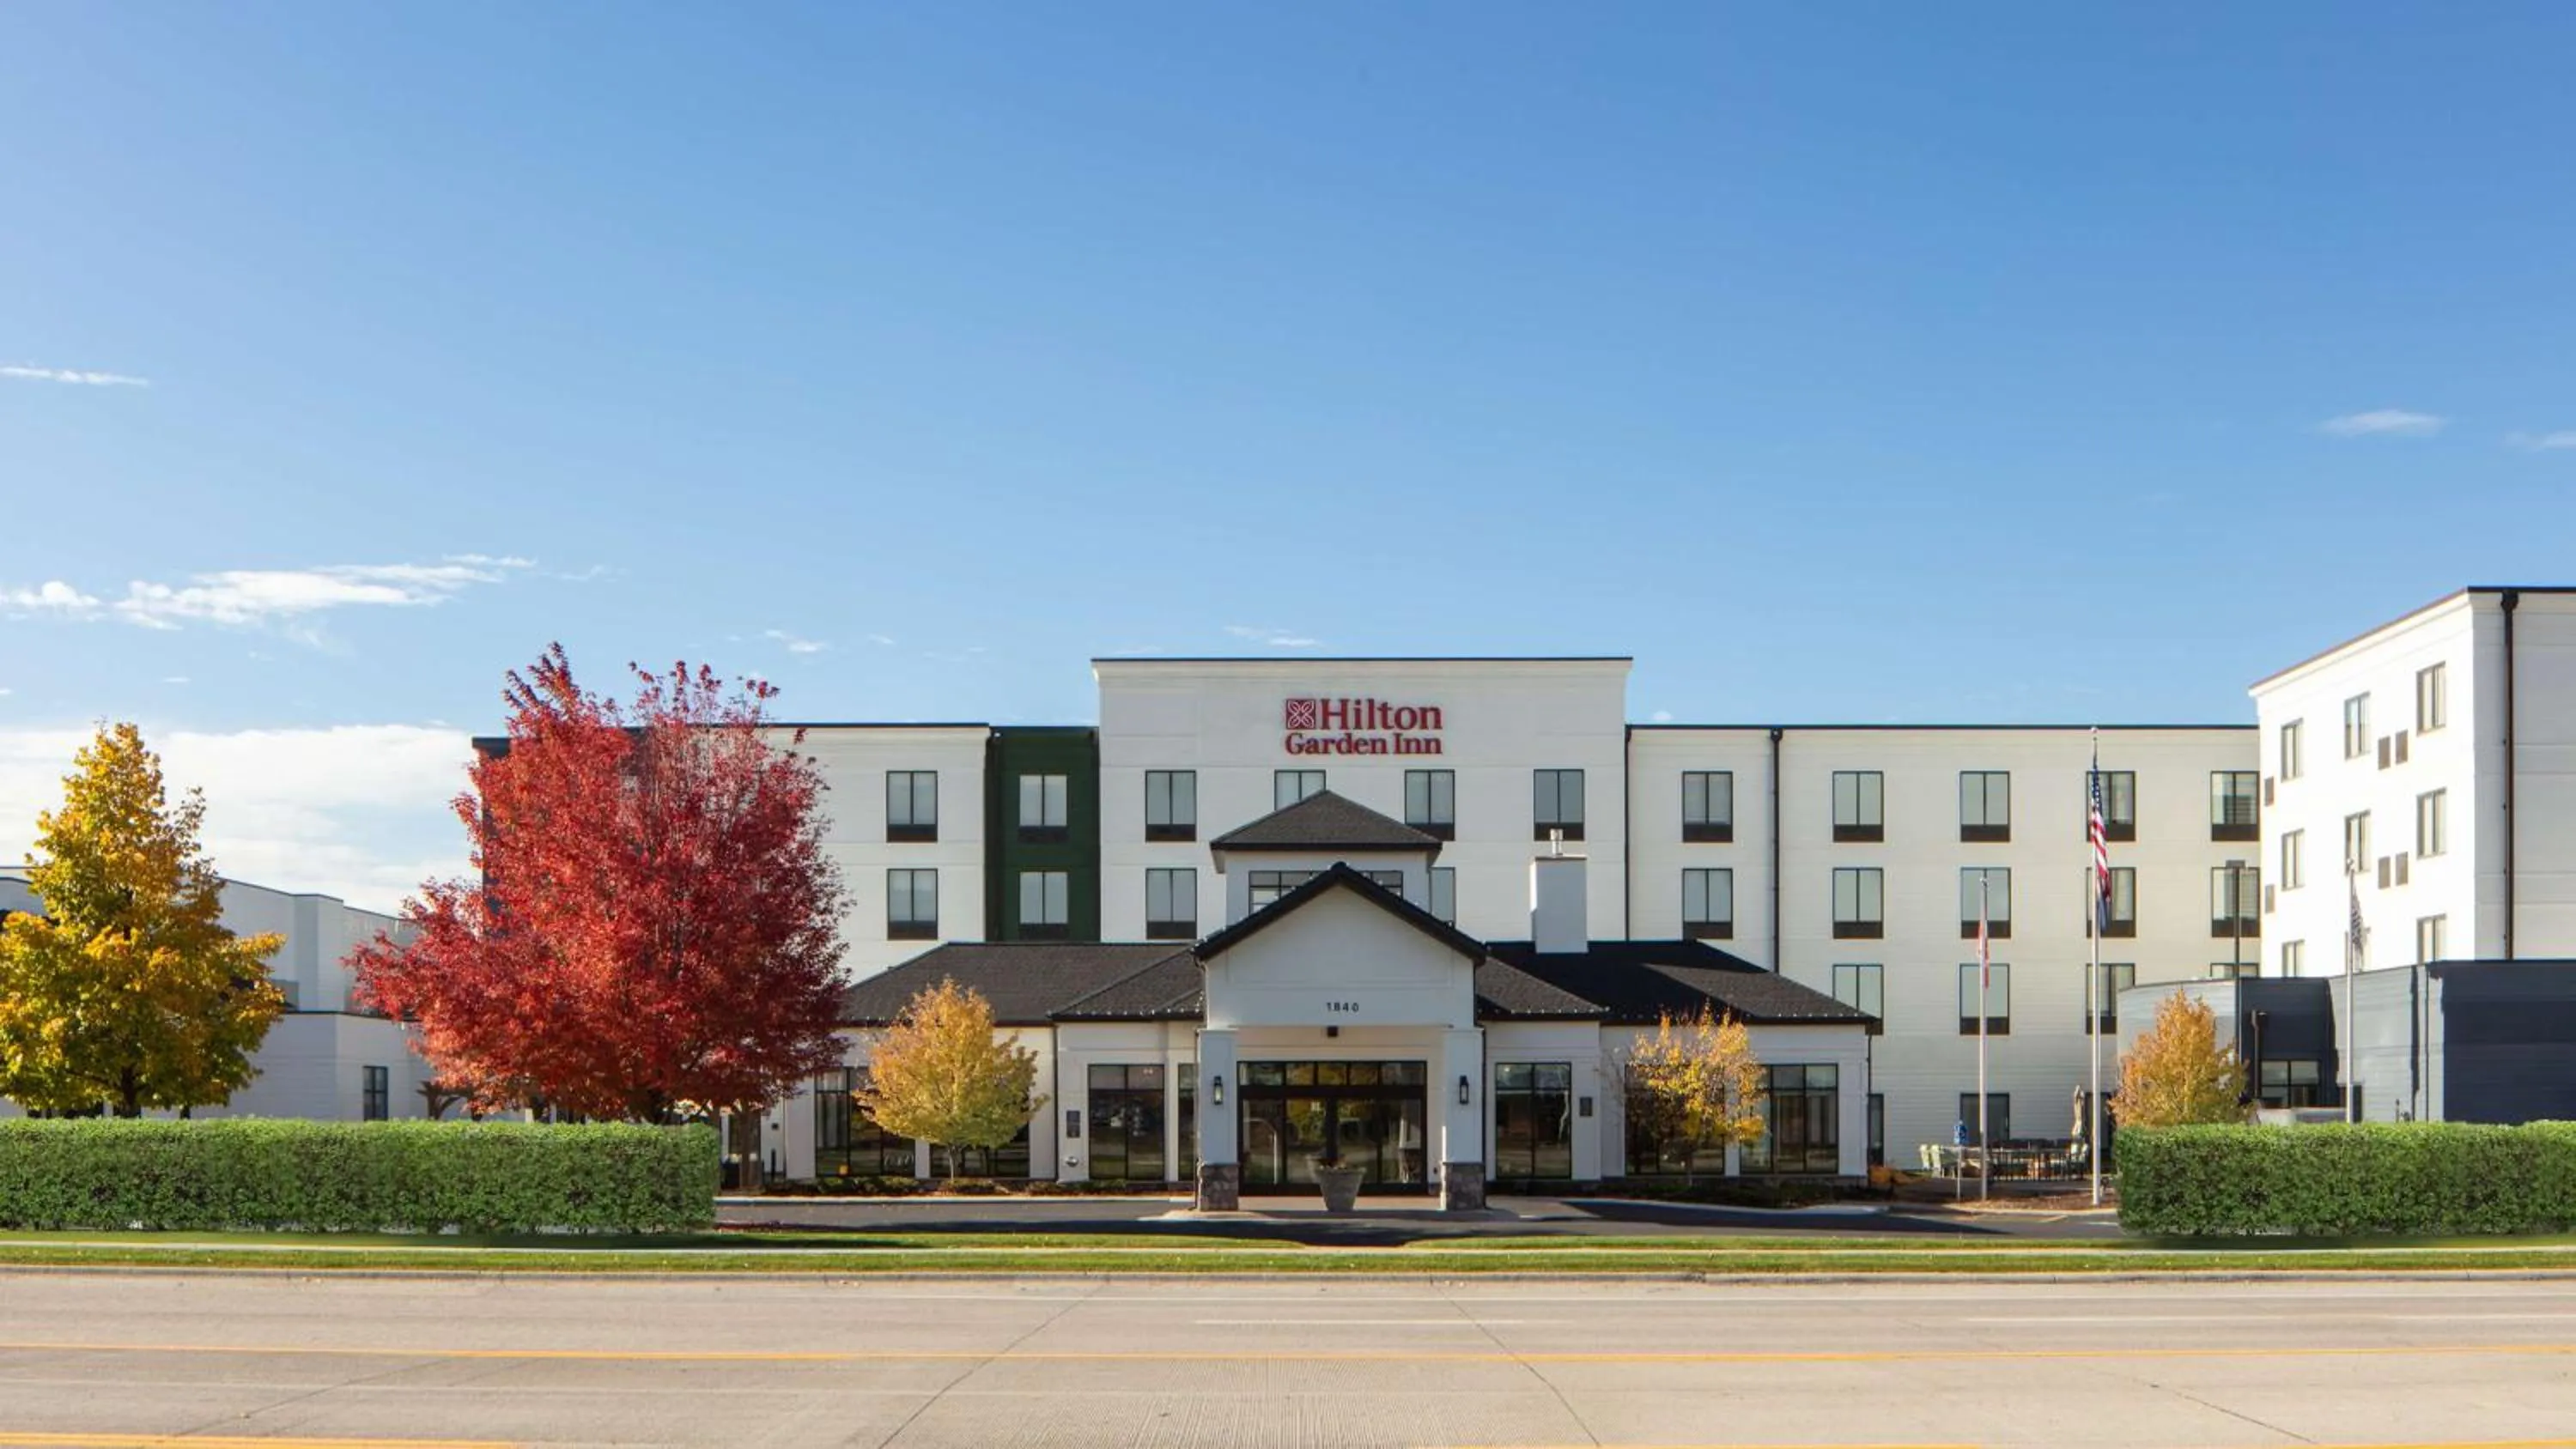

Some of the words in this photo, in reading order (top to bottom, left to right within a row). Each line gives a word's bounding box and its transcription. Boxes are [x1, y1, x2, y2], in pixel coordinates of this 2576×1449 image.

[1321, 698, 1443, 730] Hilton
[1285, 733, 1388, 755] Garden
[1393, 733, 1443, 755] Inn
